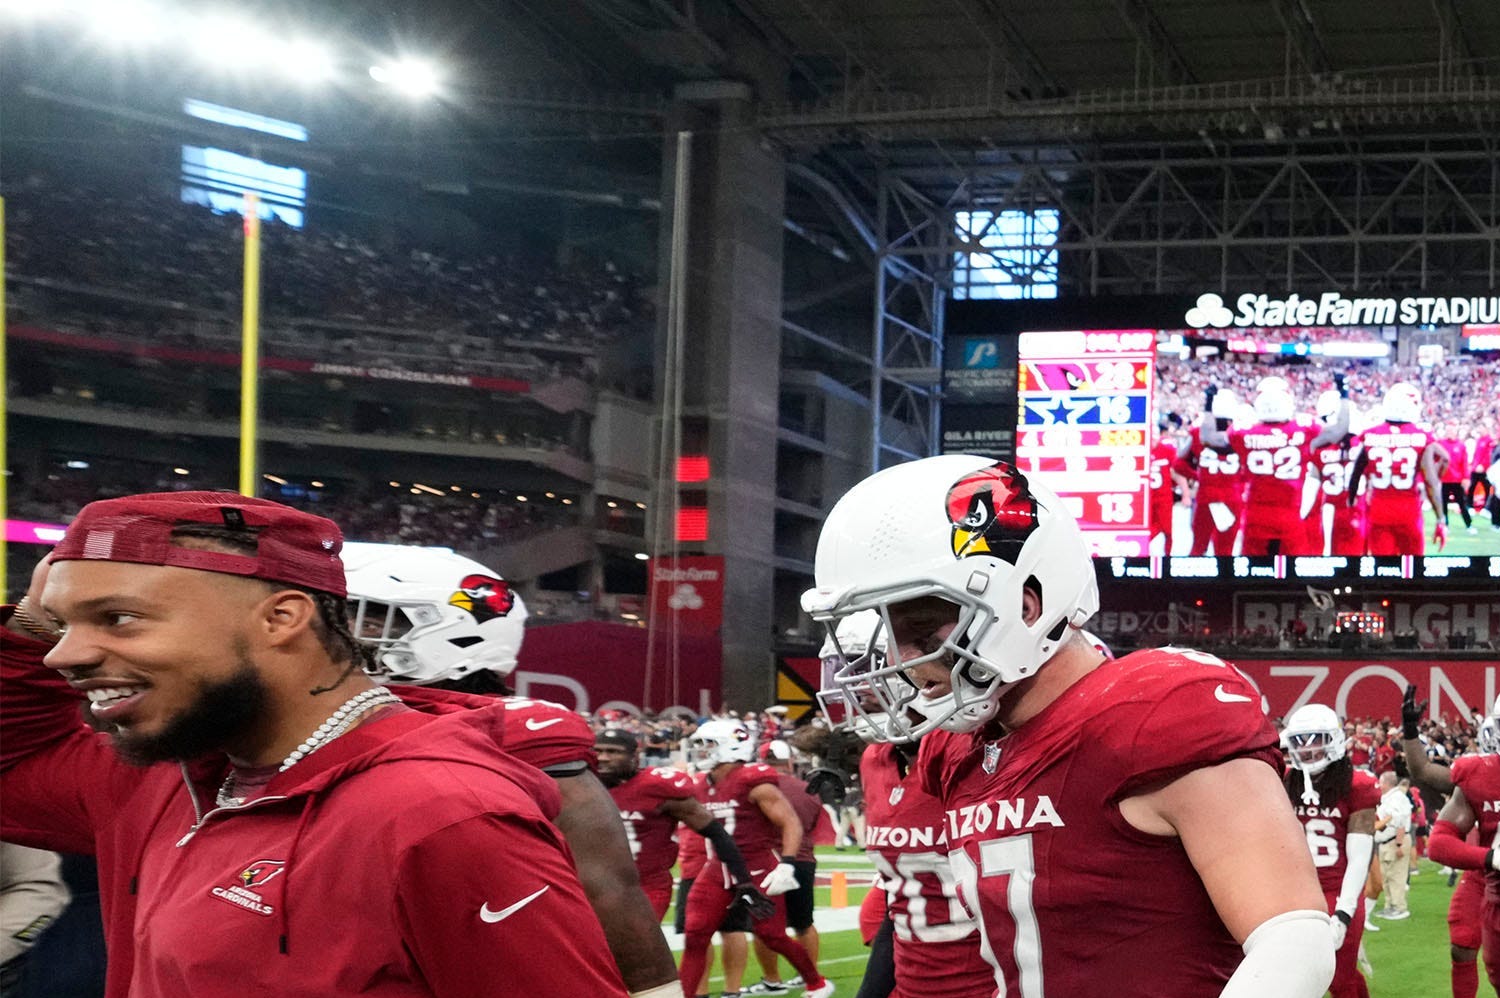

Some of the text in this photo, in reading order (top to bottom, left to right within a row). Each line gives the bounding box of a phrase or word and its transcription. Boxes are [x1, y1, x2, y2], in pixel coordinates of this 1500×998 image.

[1096, 396, 1131, 423] 16
[1368, 446, 1417, 489] 33
[945, 795, 1066, 840] IZONA
[211, 886, 274, 915] CARDINALS
